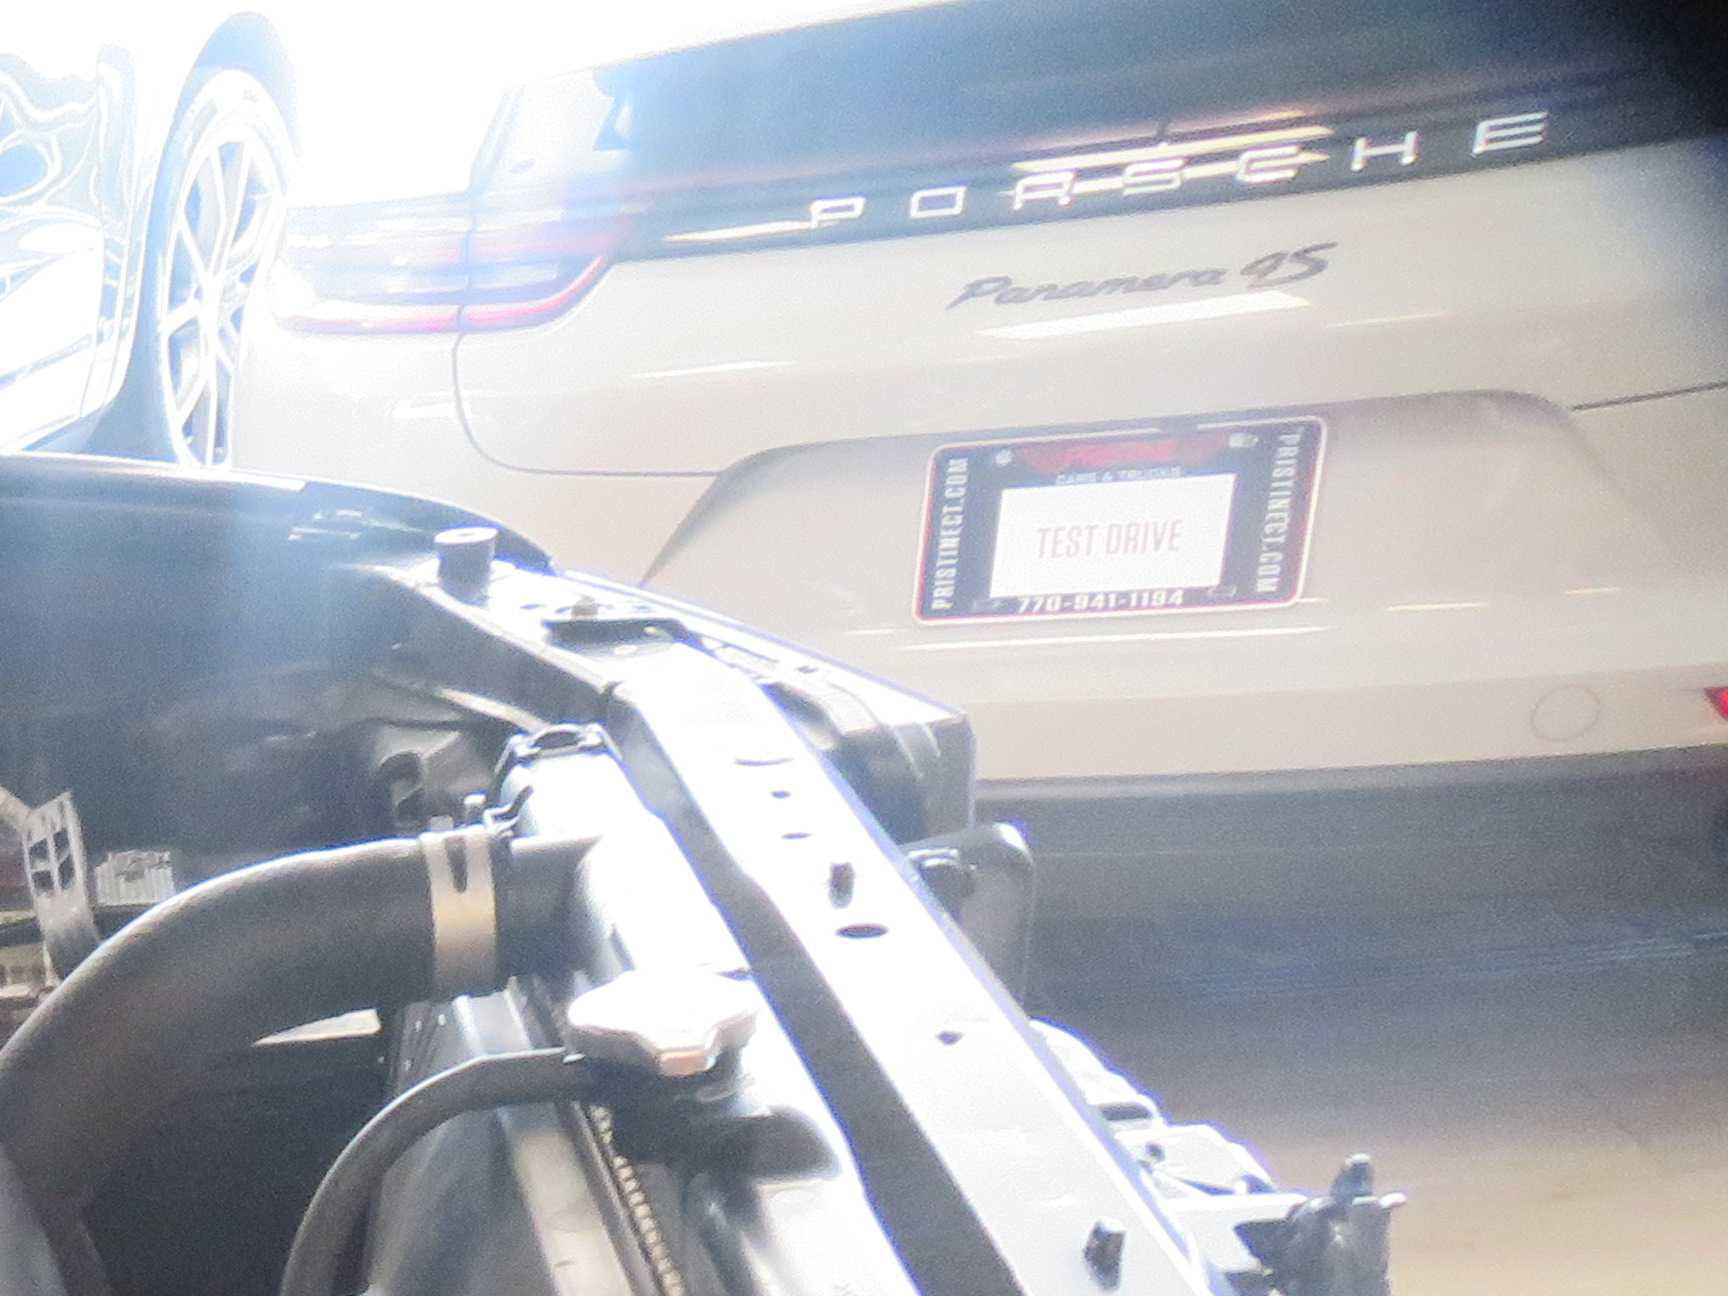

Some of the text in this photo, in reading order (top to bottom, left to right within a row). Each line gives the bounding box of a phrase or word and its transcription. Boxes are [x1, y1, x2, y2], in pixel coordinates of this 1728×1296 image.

[811, 112, 1548, 226] PORSCHE
[945, 242, 1338, 310] Panamera 4S
[1037, 518, 1184, 559] TEST DRIVE
